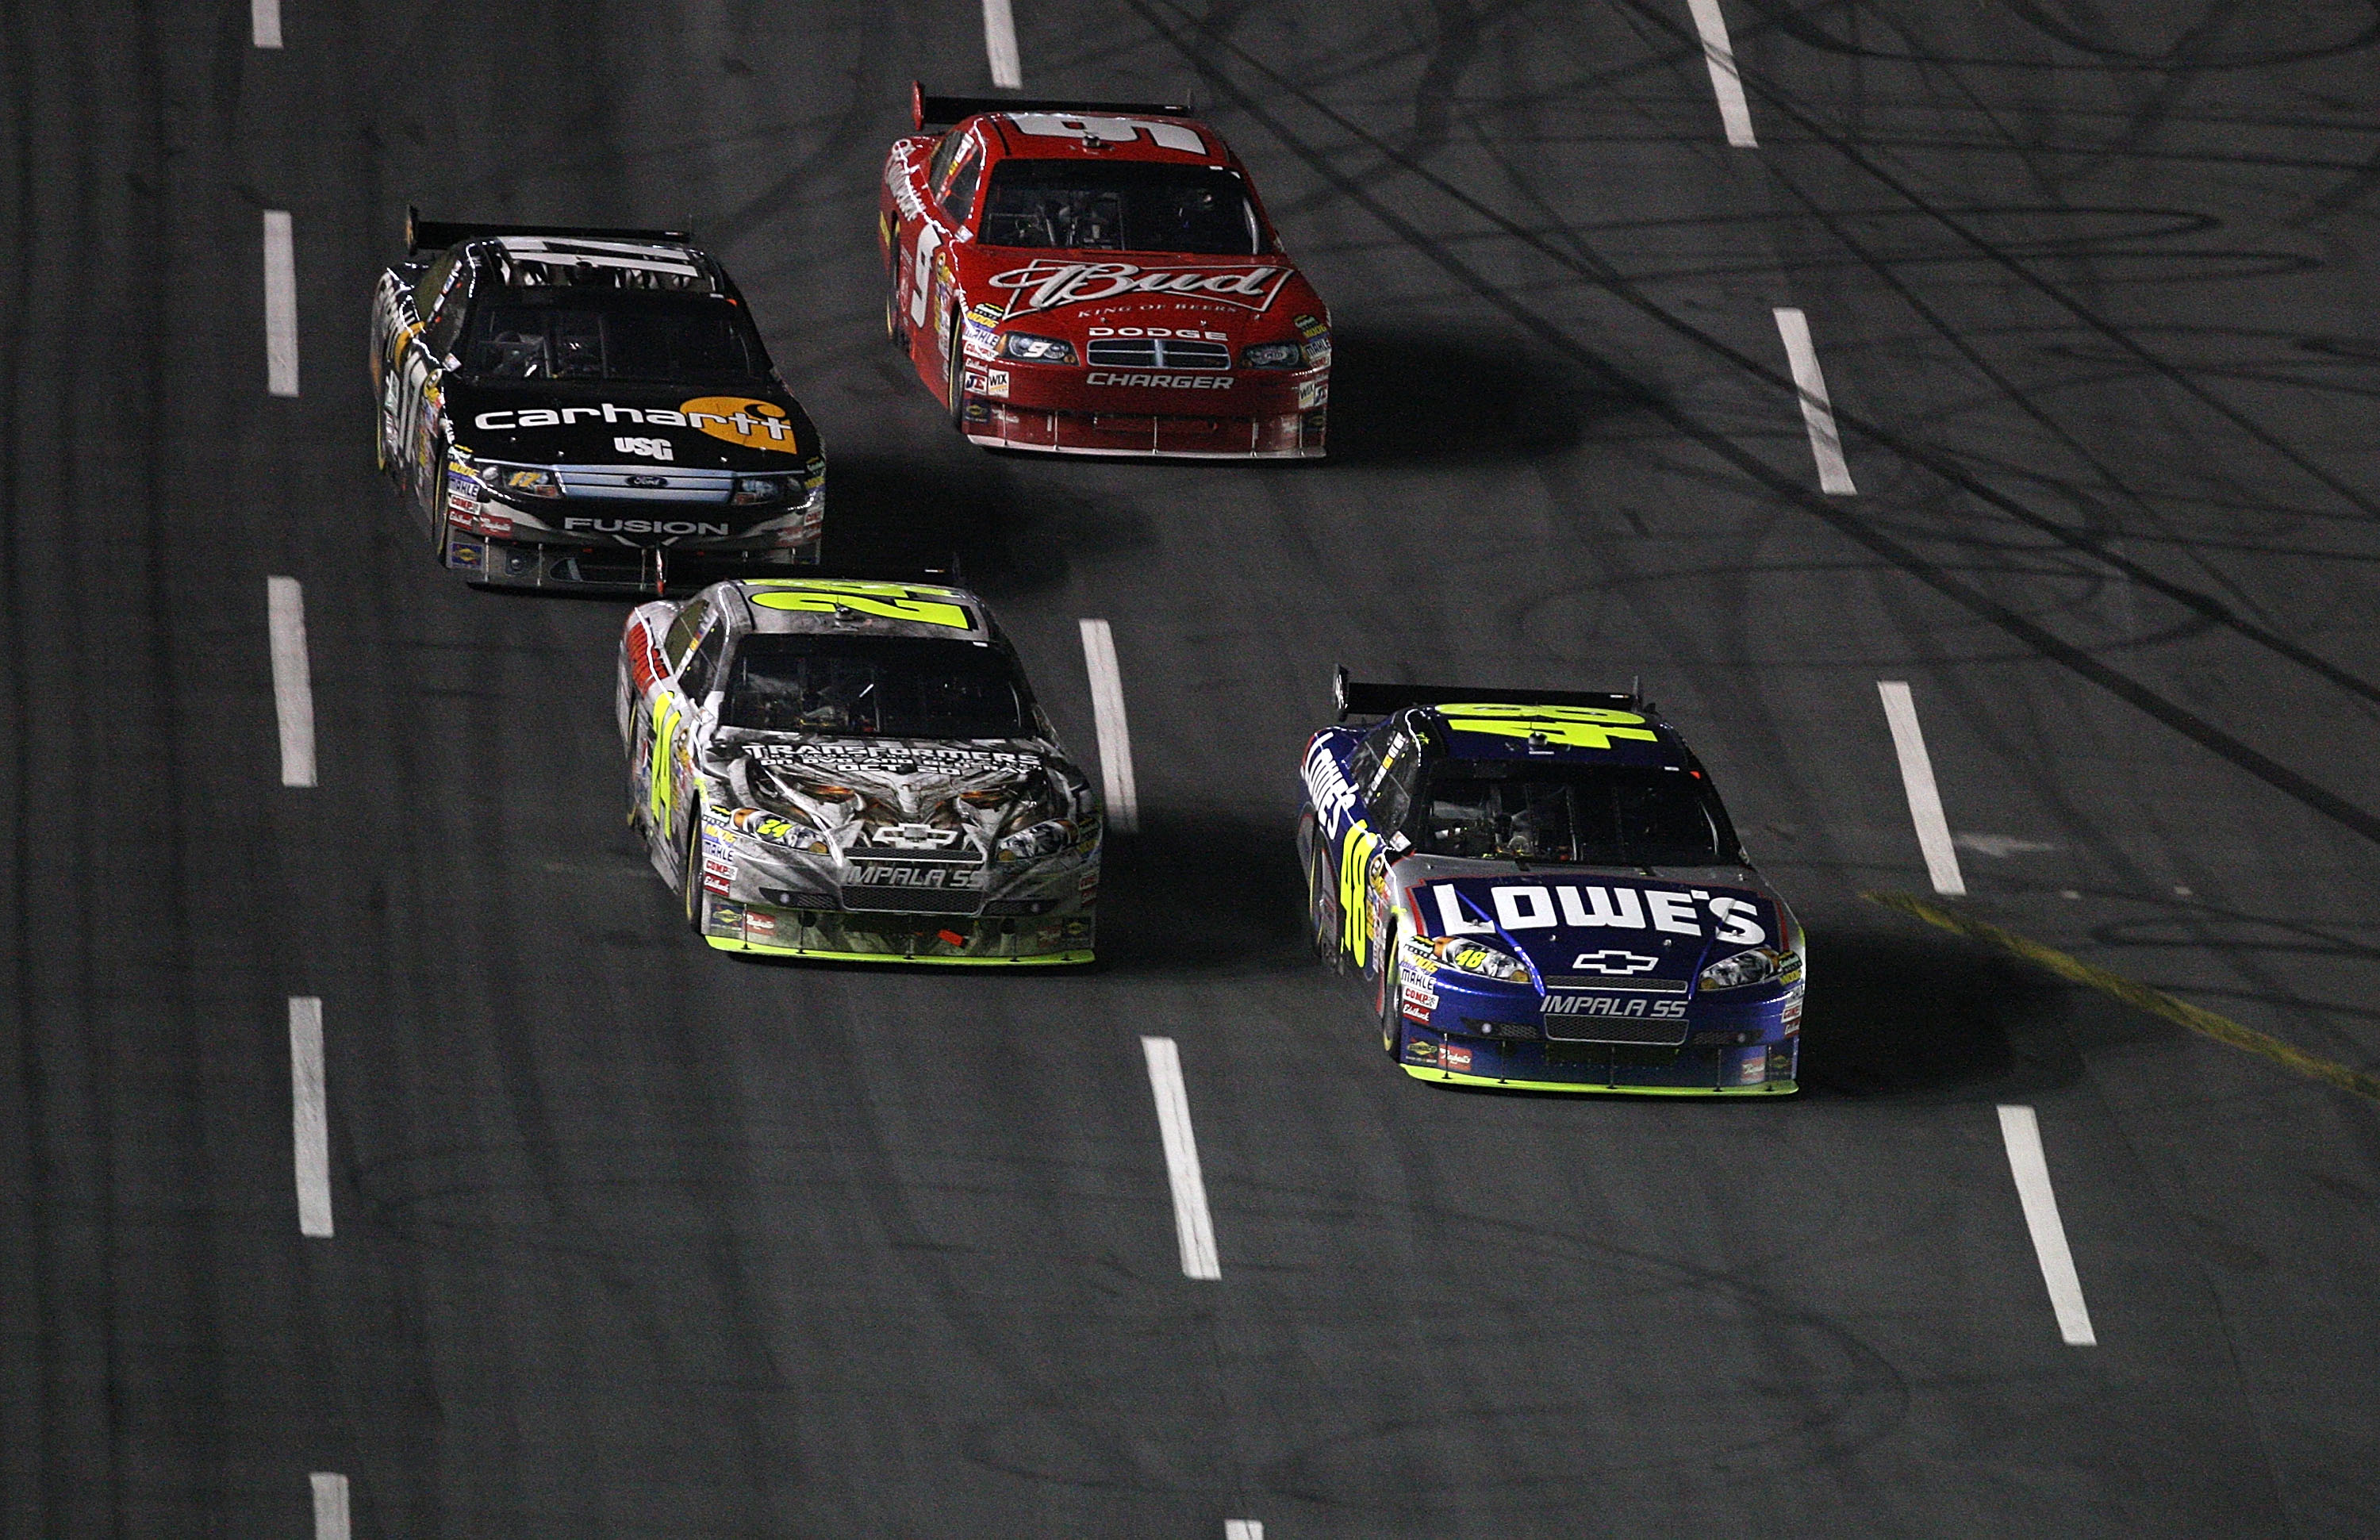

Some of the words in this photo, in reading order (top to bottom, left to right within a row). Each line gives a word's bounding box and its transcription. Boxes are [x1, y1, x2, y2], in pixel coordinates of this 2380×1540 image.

[911, 223, 942, 328] 9
[989, 263, 1270, 308] Bud
[1088, 327, 1228, 341] DODGE
[1023, 341, 1053, 358] 9
[988, 374, 1008, 386] WIX
[1086, 372, 1234, 389] CHARGER
[475, 403, 791, 441] carhartt
[614, 436, 674, 461] USG
[509, 471, 542, 487] 17
[565, 517, 729, 537] FUSION
[742, 744, 1041, 766] TRANSFORMERS
[917, 766, 961, 775] 20
[756, 819, 793, 839] 24
[1433, 883, 1766, 945] LOWE'S
[1455, 948, 1487, 968] 48
[1402, 968, 1437, 991] MAHLE
[1405, 987, 1428, 1003] COMP
[1540, 994, 1651, 1016] IMPALA
[1650, 1000, 1688, 1018] SS
